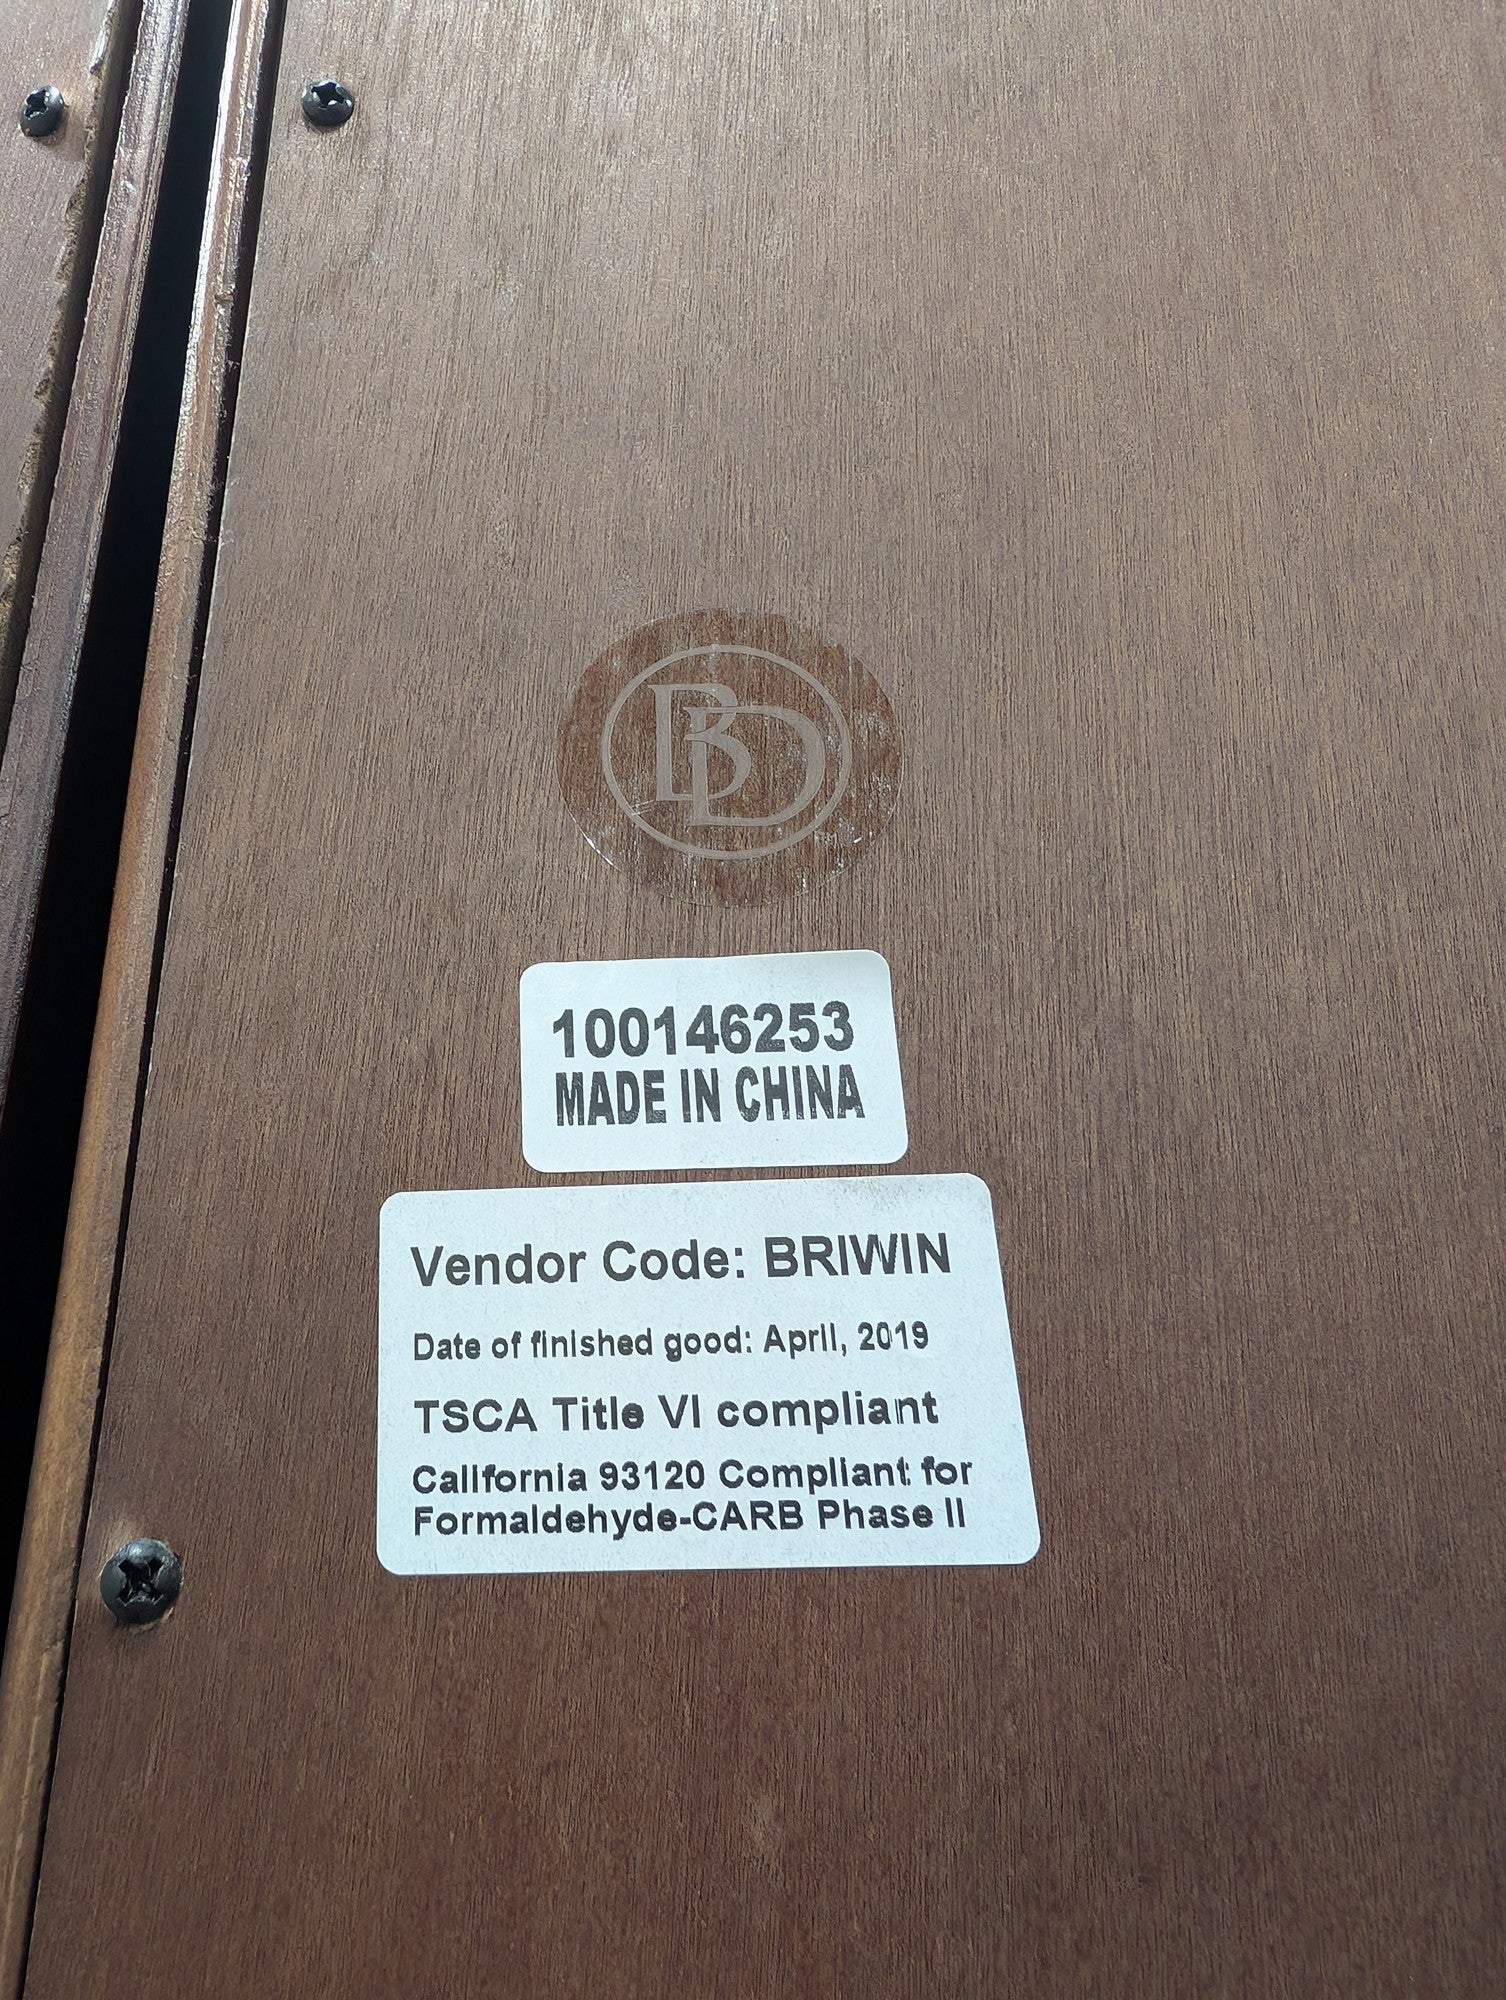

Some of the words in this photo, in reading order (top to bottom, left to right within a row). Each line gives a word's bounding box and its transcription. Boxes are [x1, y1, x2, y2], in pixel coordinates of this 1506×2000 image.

[552, 1000, 855, 1059] 100146253
[555, 1069, 667, 1127] MADE
[680, 1067, 722, 1123] IN
[735, 1064, 866, 1123] CHINA
[410, 1243, 587, 1287] Vendor
[602, 1238, 745, 1282] Code:
[764, 1232, 951, 1278] BRIWIN
[414, 1332, 481, 1361] Date
[491, 1330, 522, 1359] of
[530, 1327, 653, 1358] finished
[664, 1324, 752, 1363] good:
[763, 1322, 847, 1360] April,
[857, 1320, 929, 1351] 2019
[413, 1397, 538, 1434] TSCA
[552, 1395, 645, 1431] Title
[657, 1393, 701, 1429] VI
[717, 1390, 939, 1435] compliant
[412, 1462, 588, 1495] California
[599, 1459, 705, 1491] 93120
[718, 1456, 909, 1496] Compliant
[920, 1455, 973, 1486] for
[414, 1499, 804, 1541] Formaldehyde-CARB
[817, 1498, 934, 1530] Phase
[944, 1496, 966, 1528] II
